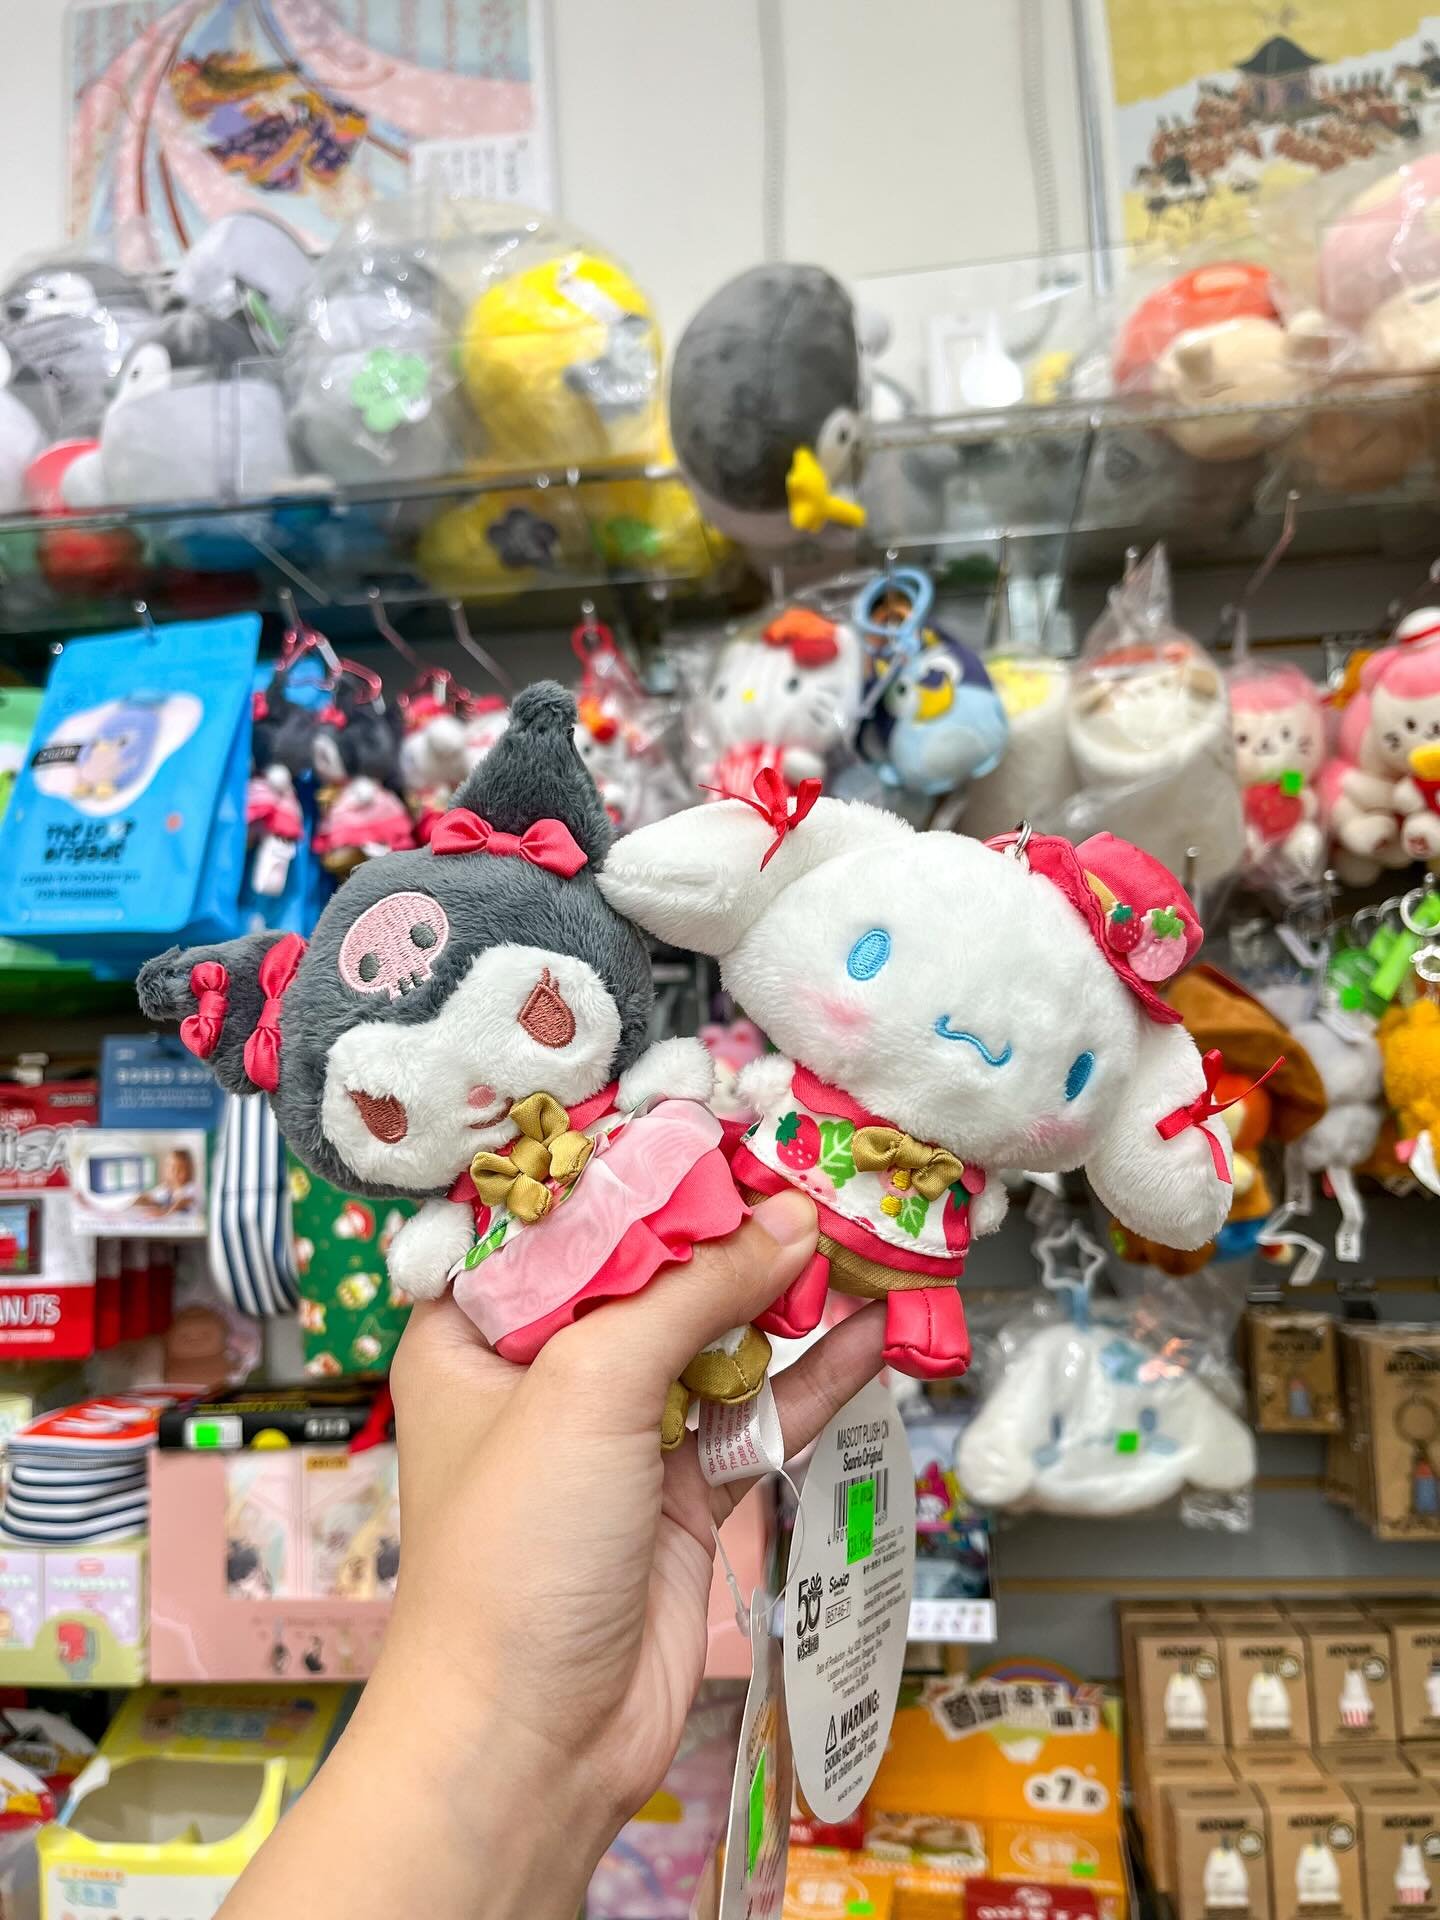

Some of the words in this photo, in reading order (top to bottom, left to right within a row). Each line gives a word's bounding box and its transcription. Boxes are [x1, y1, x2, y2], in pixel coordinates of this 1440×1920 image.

[744, 1425, 759, 1465] Location
[837, 1424, 862, 1450] MASCOT
[862, 1421, 881, 1443] PLUSH
[736, 1445, 750, 1466] Date
[863, 1443, 883, 1469] Original
[841, 1688, 879, 1740] WARNING:
